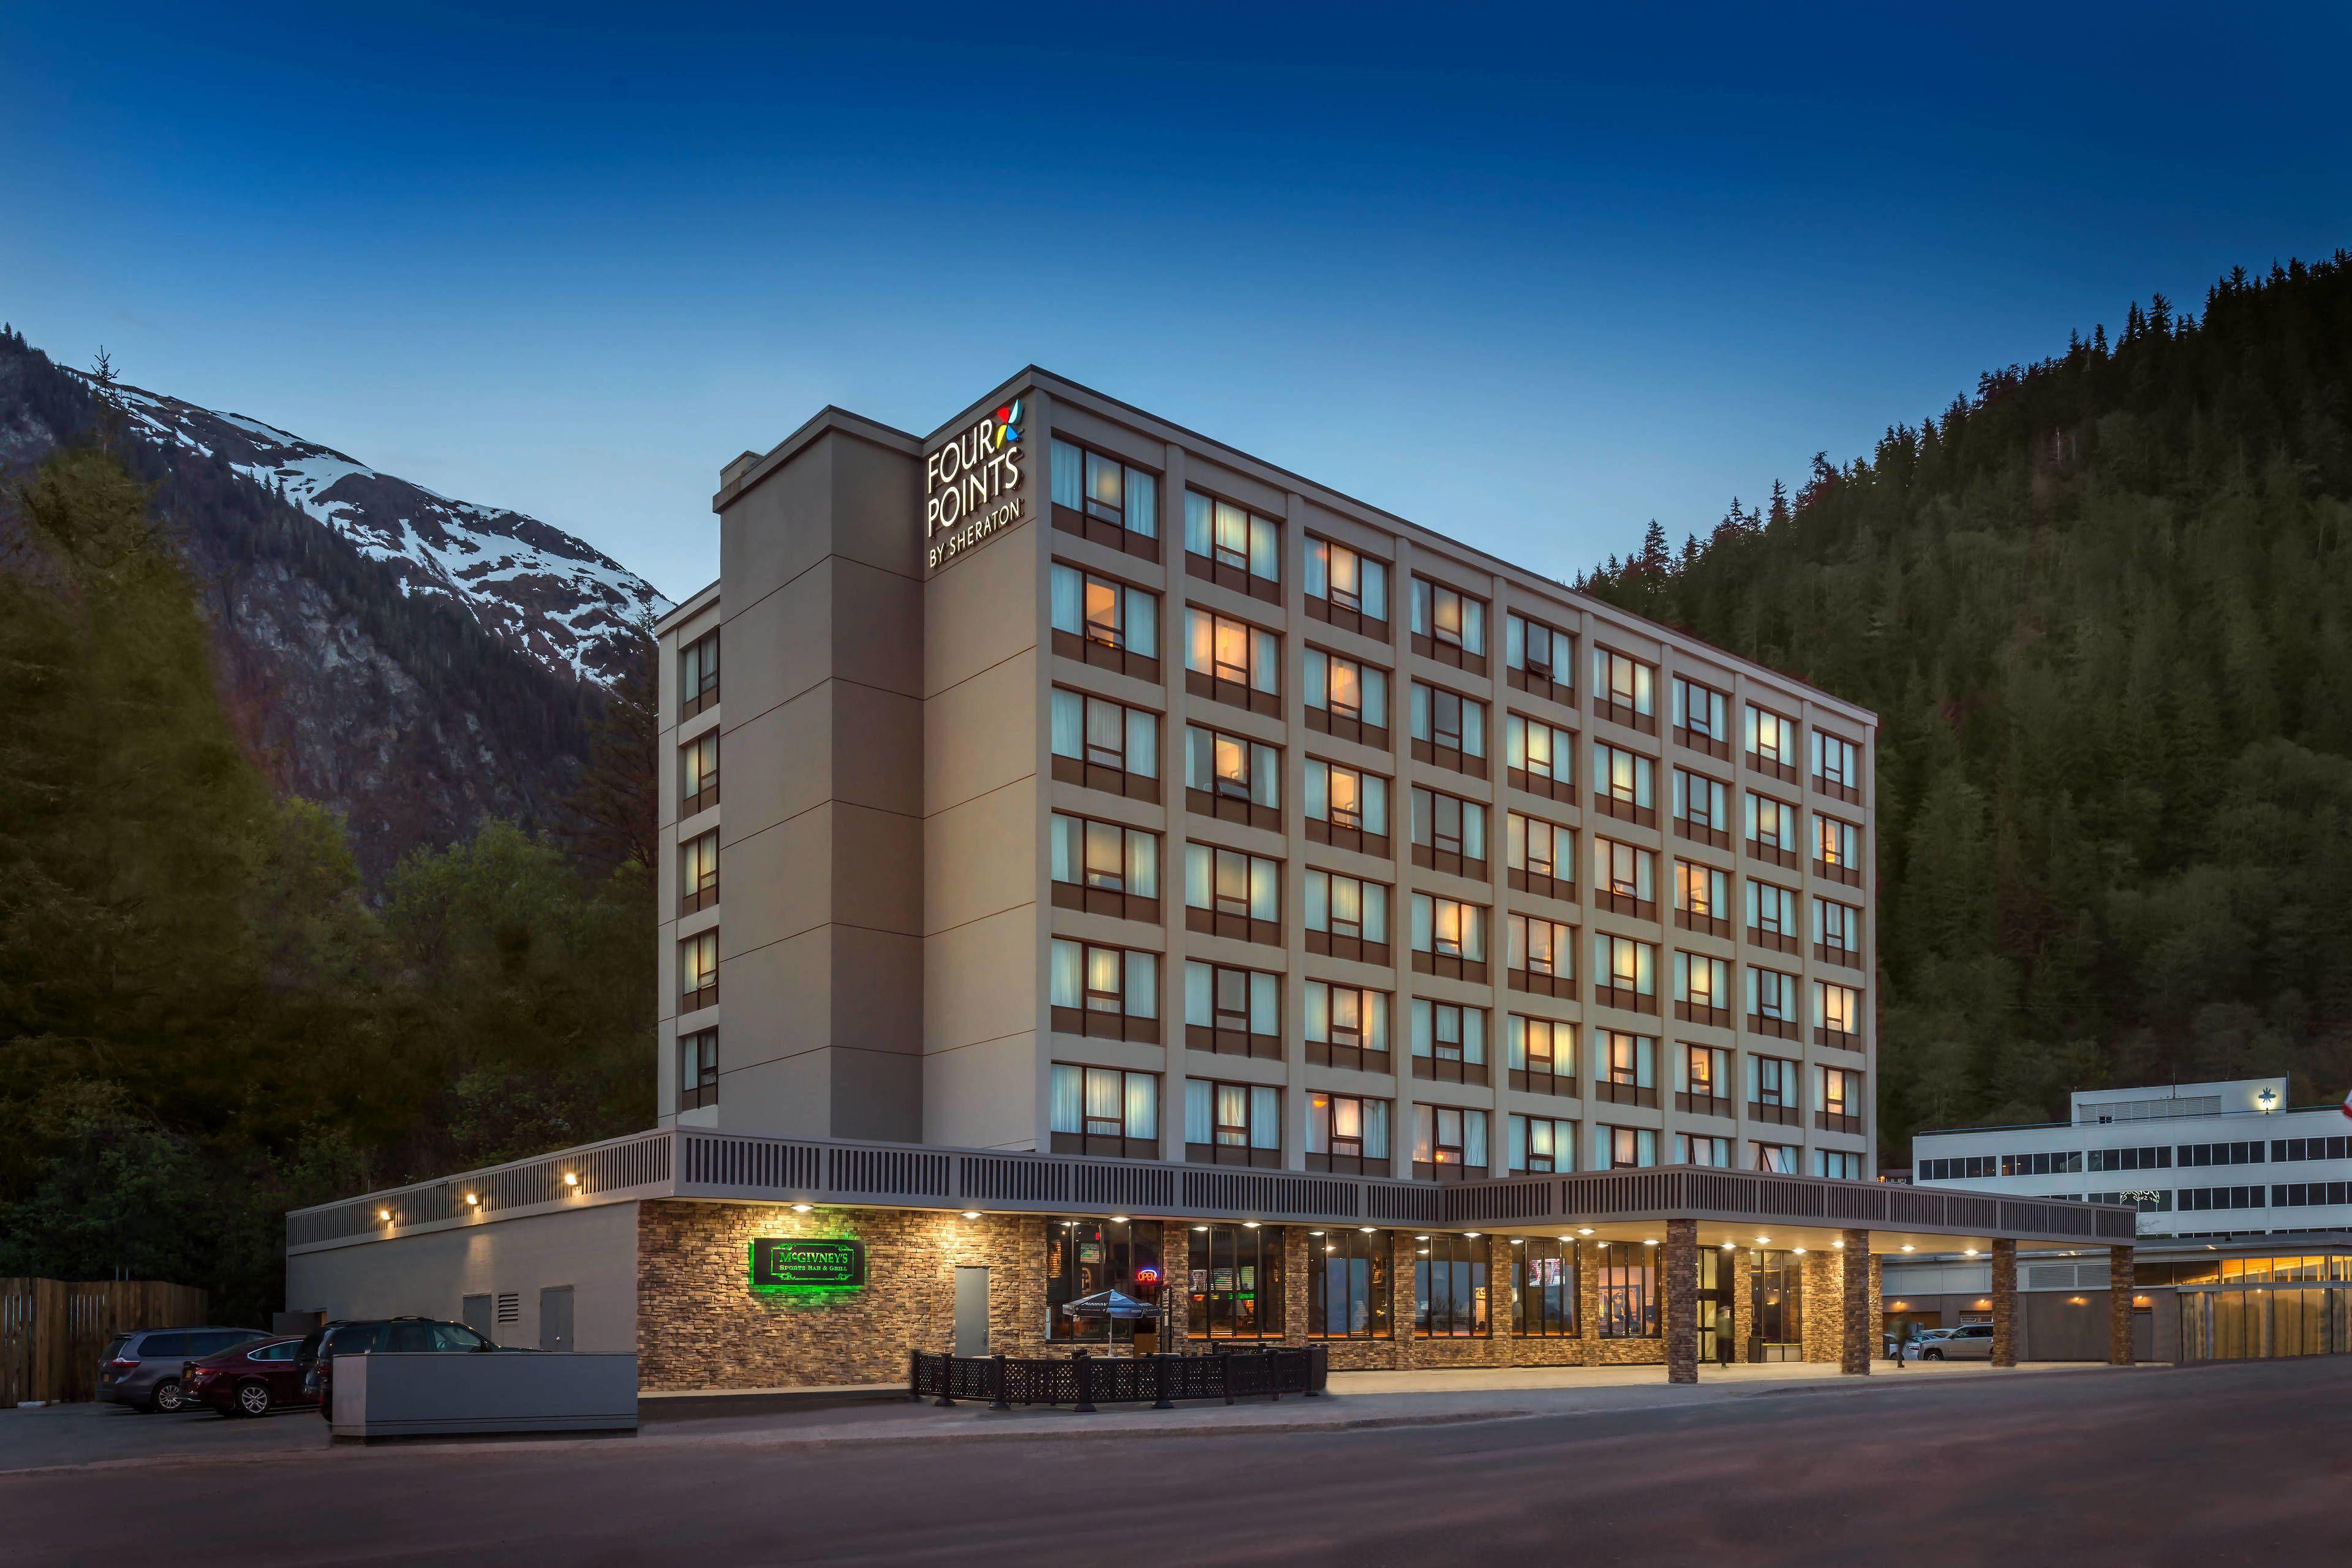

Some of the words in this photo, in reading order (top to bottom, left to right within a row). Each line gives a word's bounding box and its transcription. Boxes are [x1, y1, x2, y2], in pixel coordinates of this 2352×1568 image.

[928, 419, 995, 494] FOUR
[928, 447, 1018, 538] POINTS
[930, 543, 944, 568] BY
[949, 497, 1020, 556] SHERATON
[1139, 1272, 1156, 1281] OPEN
